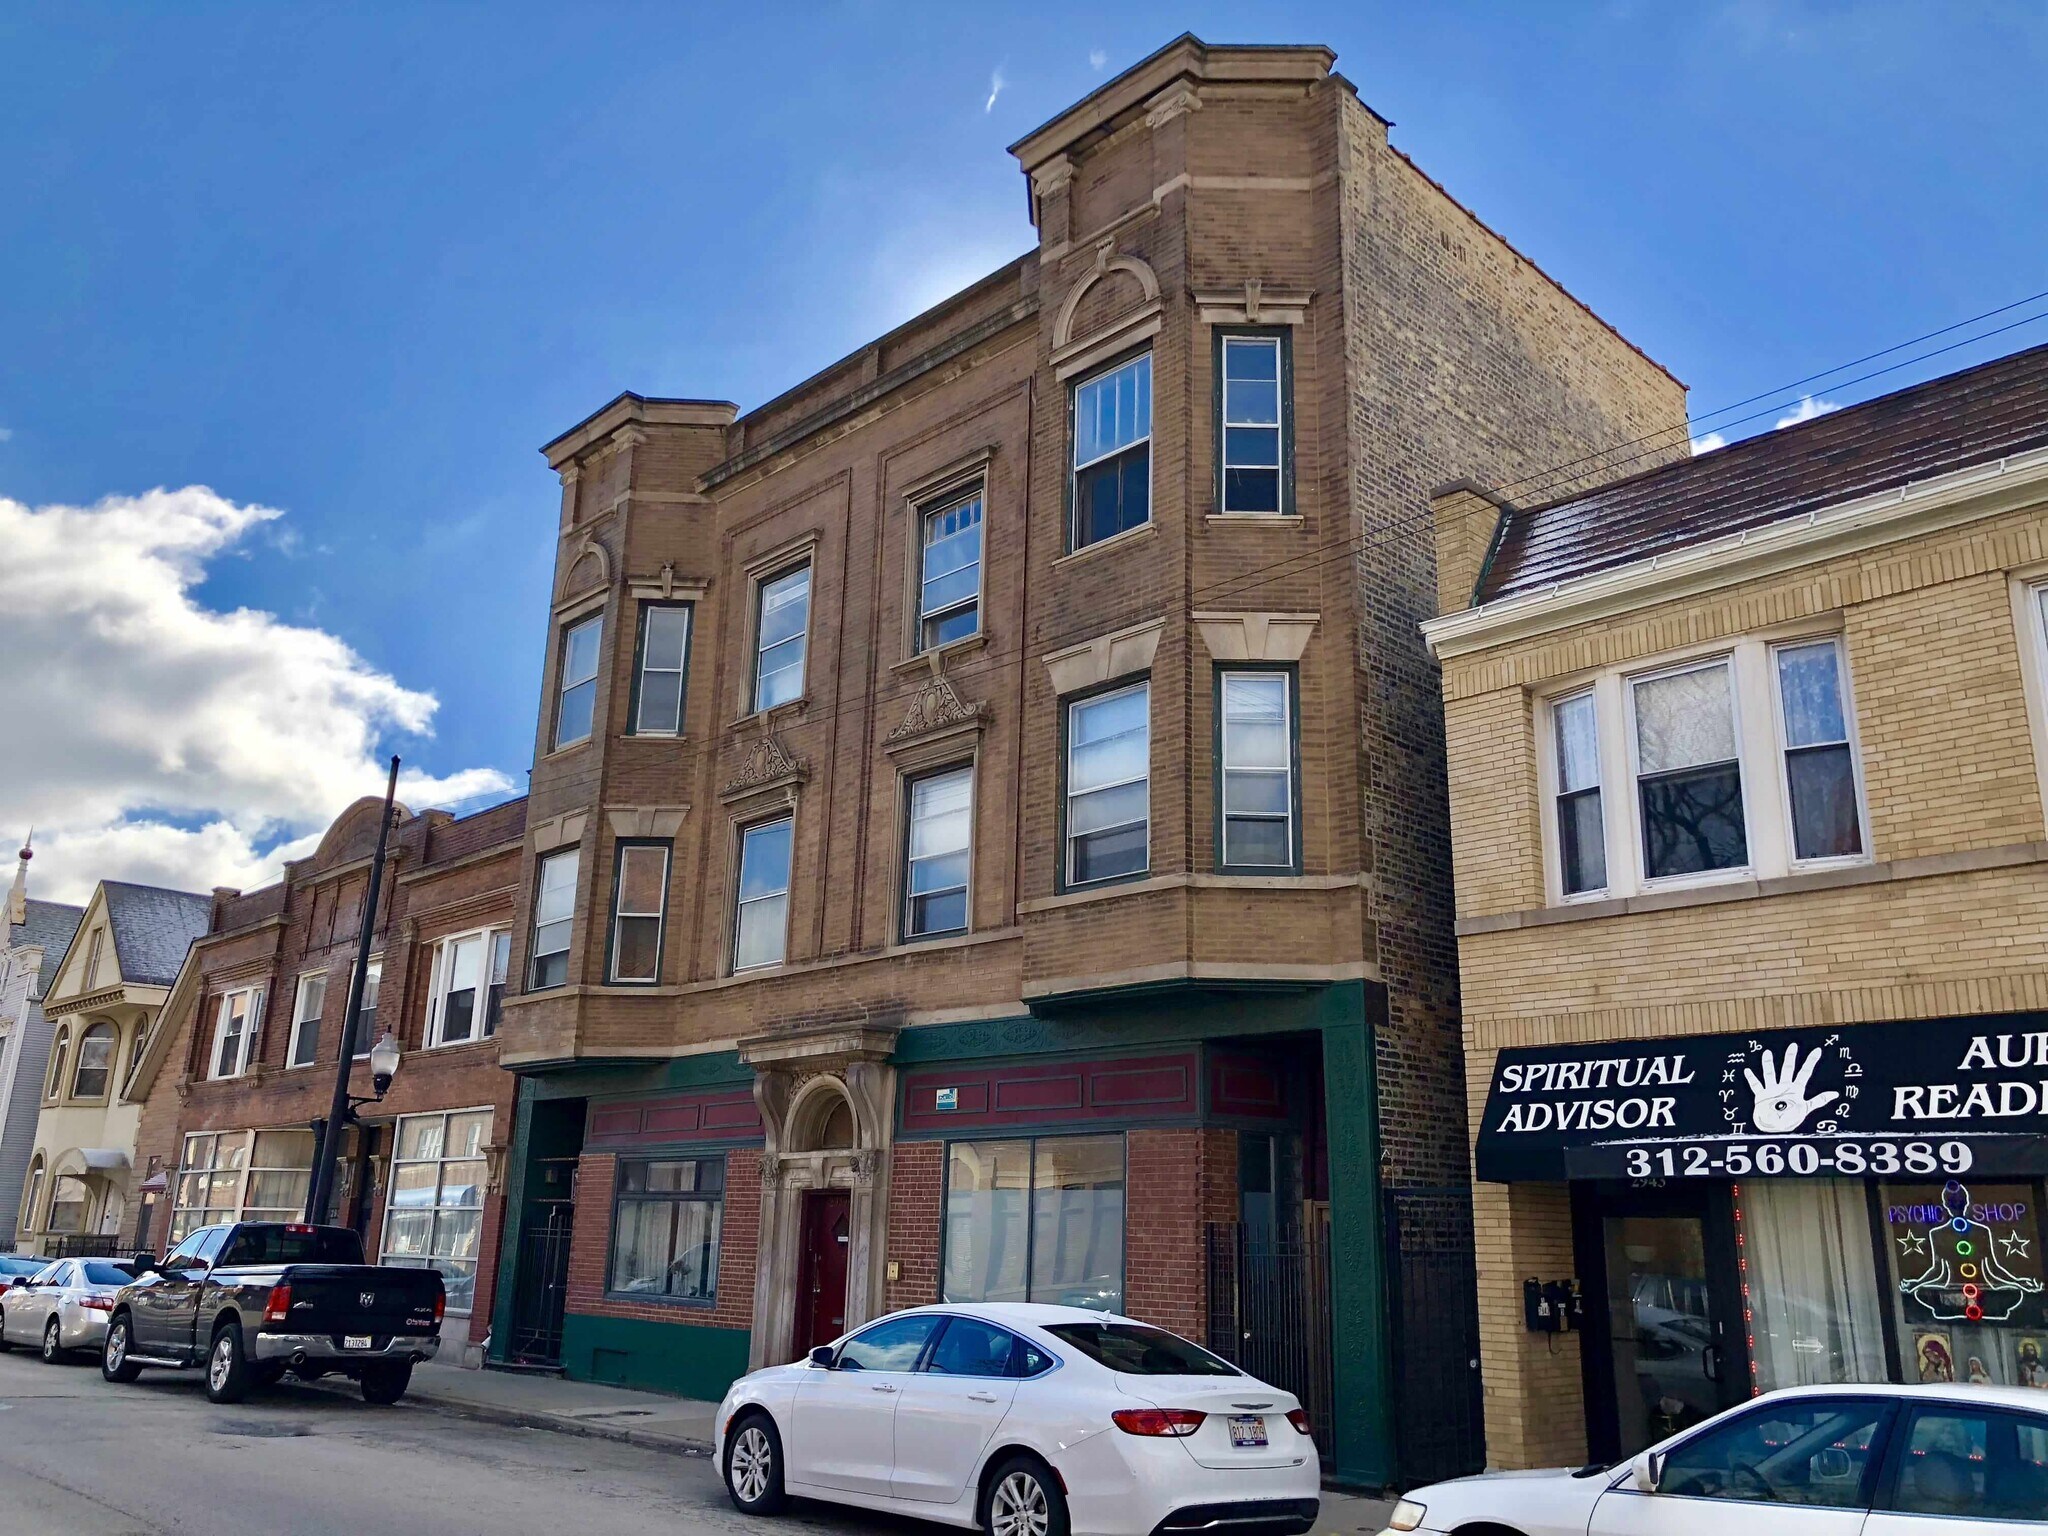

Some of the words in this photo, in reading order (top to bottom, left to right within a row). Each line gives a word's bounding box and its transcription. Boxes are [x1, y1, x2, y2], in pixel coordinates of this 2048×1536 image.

[1500, 1055, 1695, 1093] SPIRITUAL
[1496, 1097, 1676, 1132] ADVISOR
[1626, 1141, 1973, 1178] 312-560-8389
[1889, 1204, 1945, 1223] PSYCHIC
[1972, 1203, 2026, 1221] SHOP
